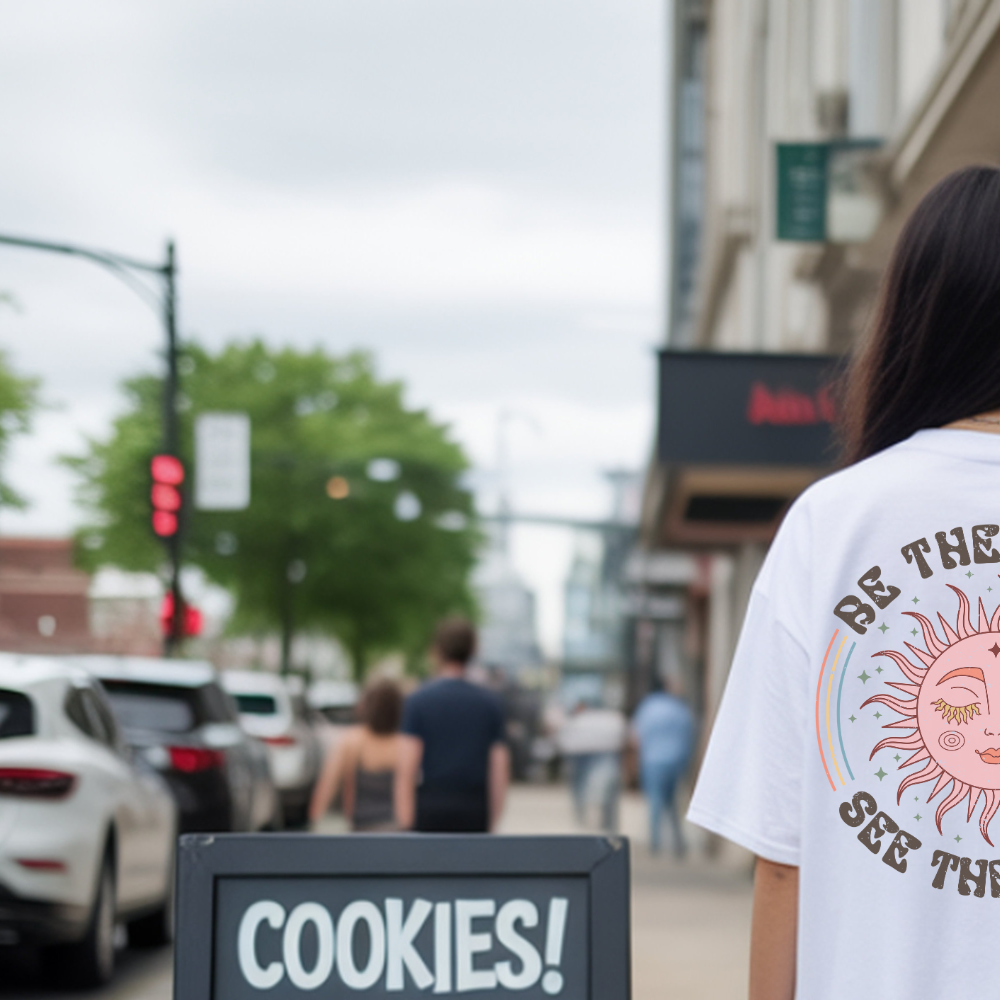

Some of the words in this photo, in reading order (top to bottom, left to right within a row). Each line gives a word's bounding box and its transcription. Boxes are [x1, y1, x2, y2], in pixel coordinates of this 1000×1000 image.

[834, 566, 901, 634] BE
[901, 524, 1000, 579] THE
[839, 791, 922, 873] SEE
[237, 897, 569, 995] COOKIES!
